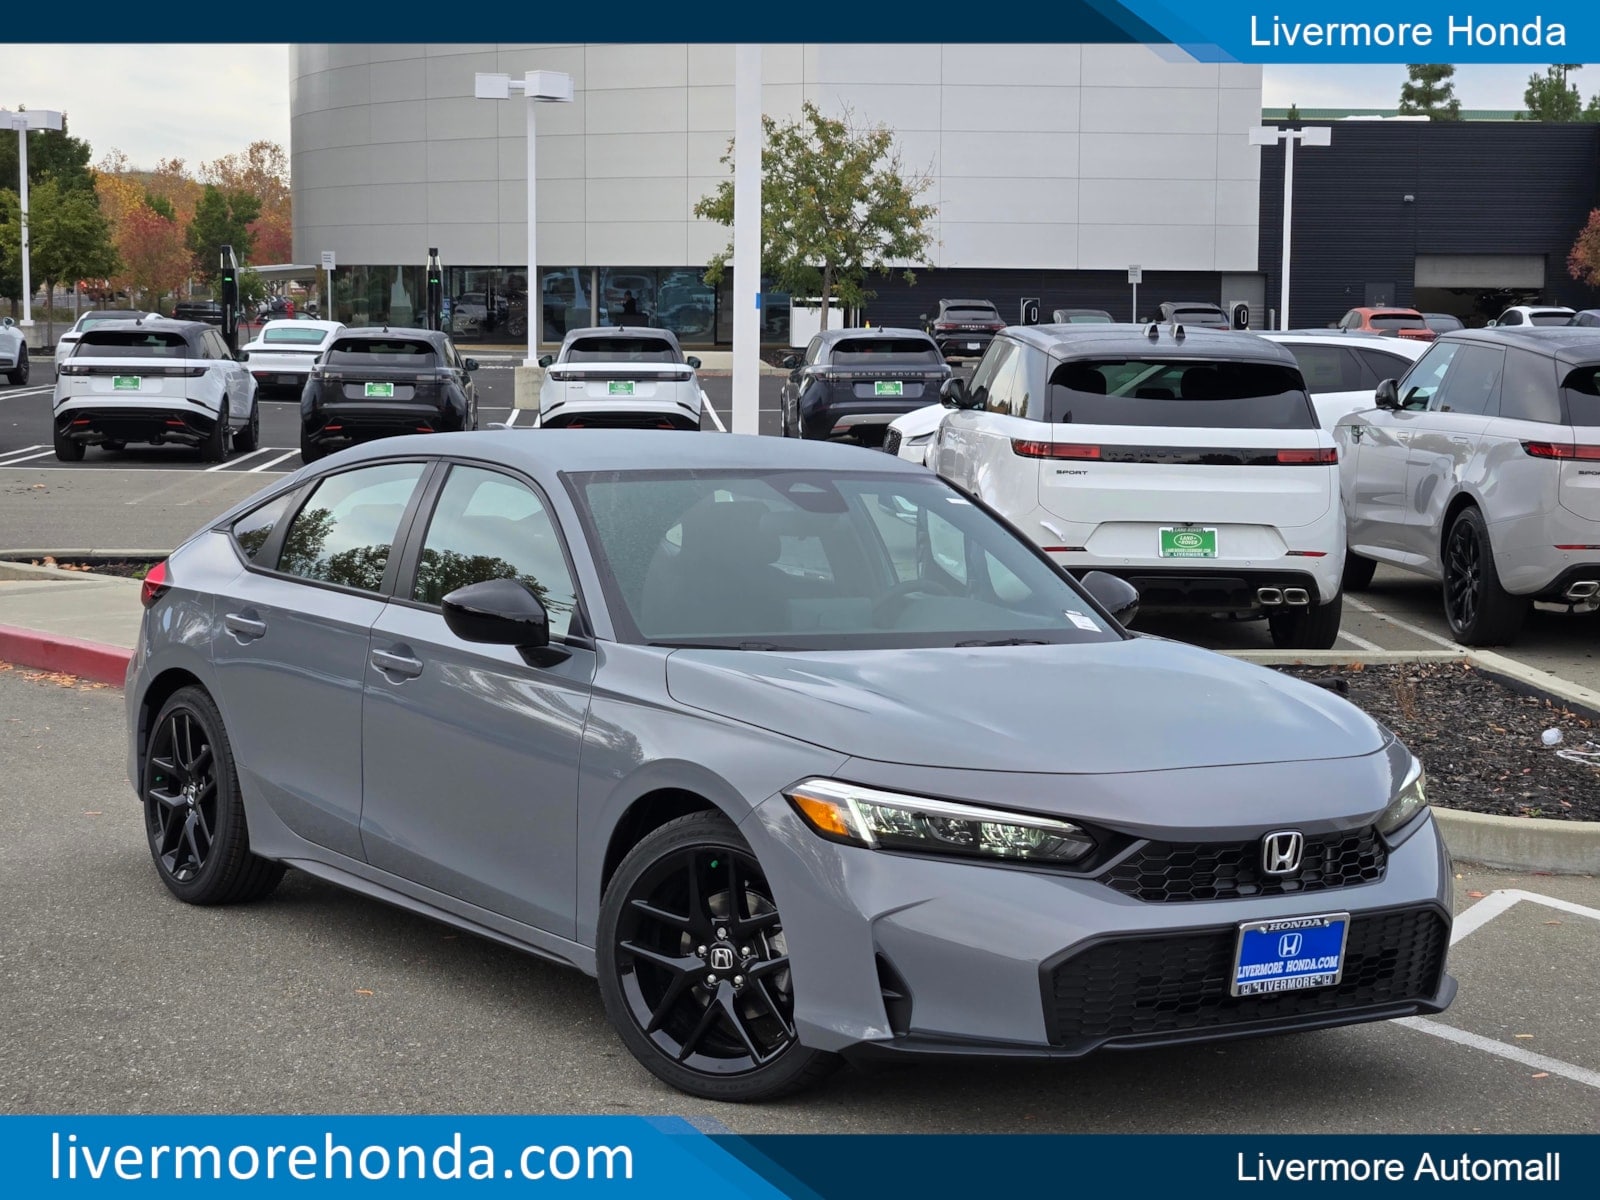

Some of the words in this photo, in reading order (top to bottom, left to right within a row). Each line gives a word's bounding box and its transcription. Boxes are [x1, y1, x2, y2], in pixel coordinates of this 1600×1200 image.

[1268, 918, 1322, 931] HONDA
[1236, 961, 1284, 979] LIVERMORE
[1285, 955, 1339, 973] HONDA.COM
[1257, 975, 1317, 993] LIVERMORE
